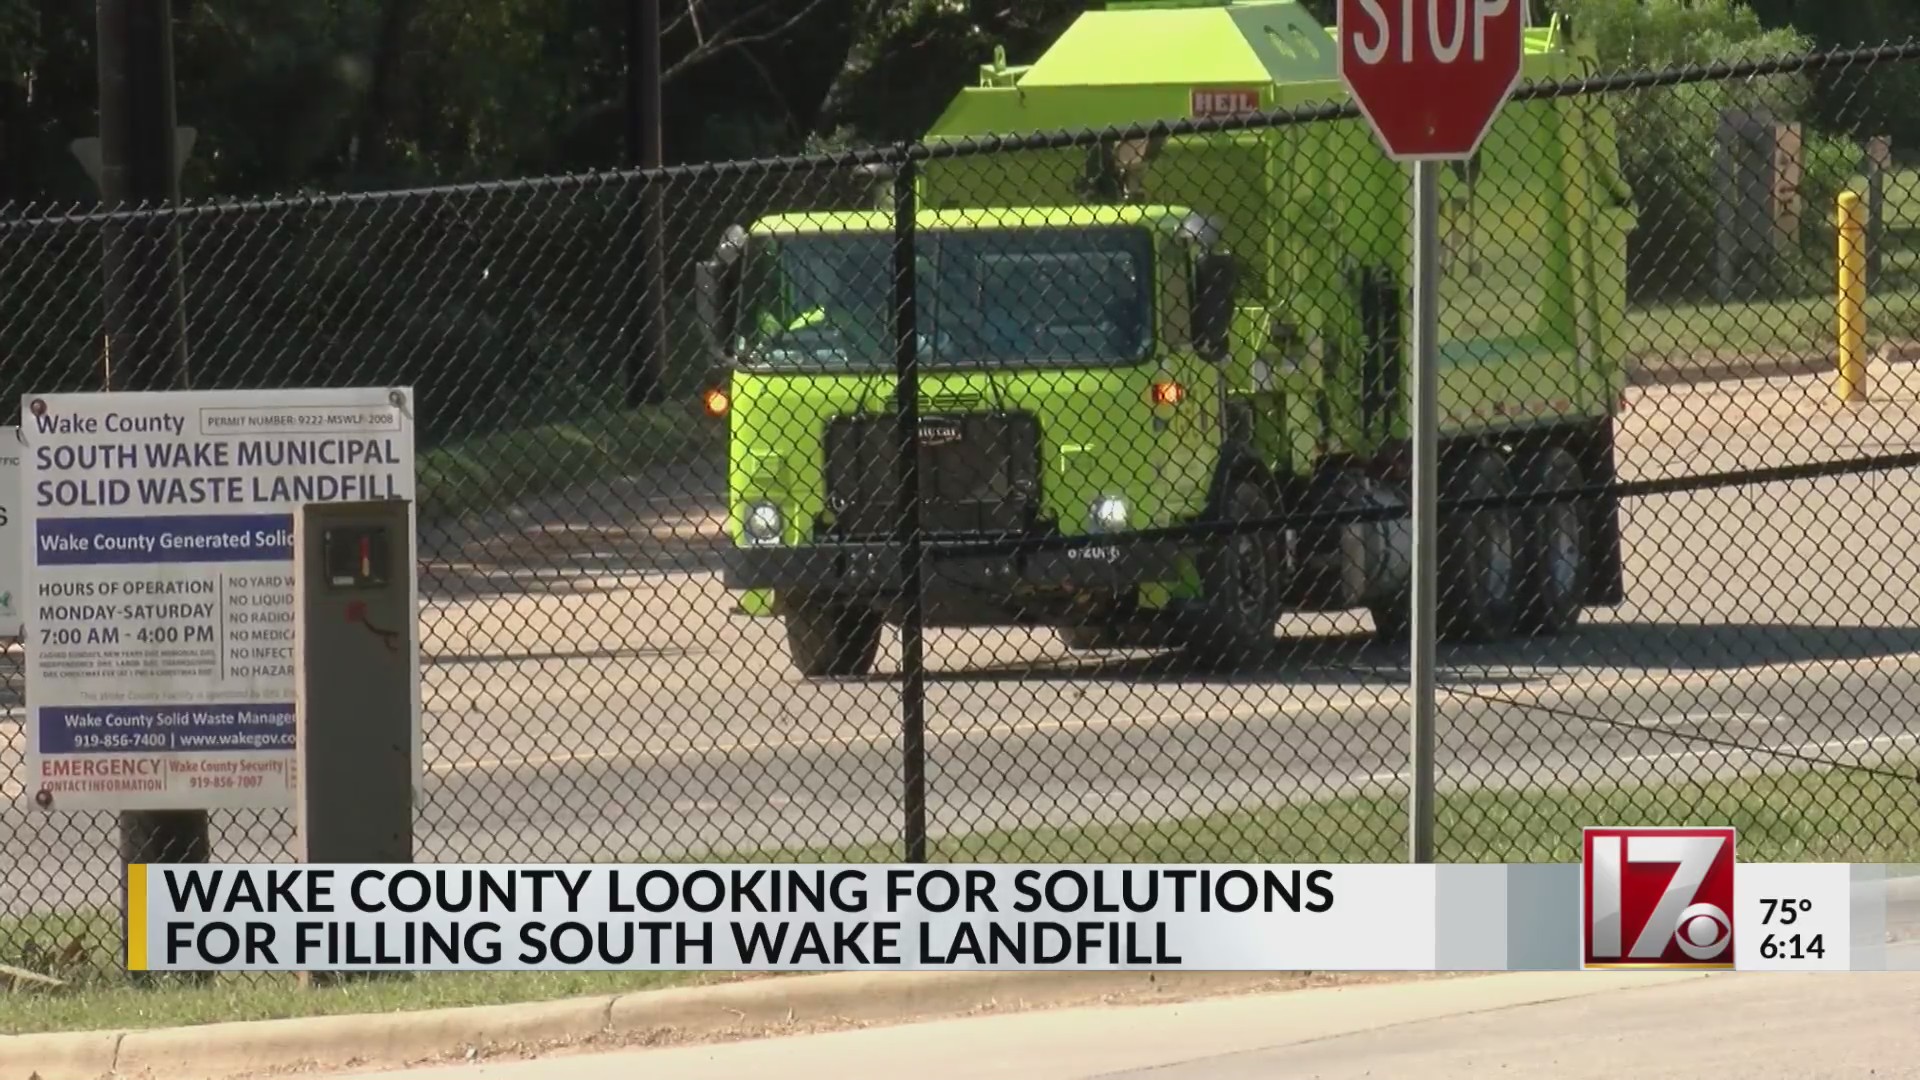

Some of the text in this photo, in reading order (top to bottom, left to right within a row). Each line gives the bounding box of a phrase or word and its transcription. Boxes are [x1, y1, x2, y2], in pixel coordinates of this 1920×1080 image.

[1353, 0, 1511, 64] STOP
[1195, 93, 1254, 112] HEIL
[36, 413, 185, 436] Wake County
[208, 416, 246, 426] PERMIT
[36, 439, 400, 470] SOUTH WAKE MUNICIPAL
[36, 474, 402, 506] SOLID WASTE LANDFILL
[41, 534, 89, 551] Wake
[93, 533, 155, 552] County
[160, 530, 251, 548] Generated
[39, 580, 214, 597] HOURS OF OPERATION
[229, 577, 248, 588] NO
[250, 576, 283, 587] YARD
[229, 595, 248, 606] NO
[39, 603, 214, 620] MONDAY-SATURDAY
[230, 613, 248, 623] NO
[40, 628, 81, 645] 7:00
[87, 627, 119, 644] AM
[137, 627, 178, 642] 4:00
[184, 625, 214, 642] PM
[230, 630, 249, 641] NO
[230, 648, 249, 659] NO
[230, 666, 249, 677] NO
[65, 714, 102, 727] Wake
[105, 713, 152, 728] County
[157, 711, 189, 726] Solid
[192, 711, 234, 725] Waste
[74, 733, 166, 747] 919-856-7400
[41, 758, 161, 777] EMERGENCY
[169, 758, 284, 774] Wake County Security
[41, 779, 162, 792] CONTACT INFORMATION
